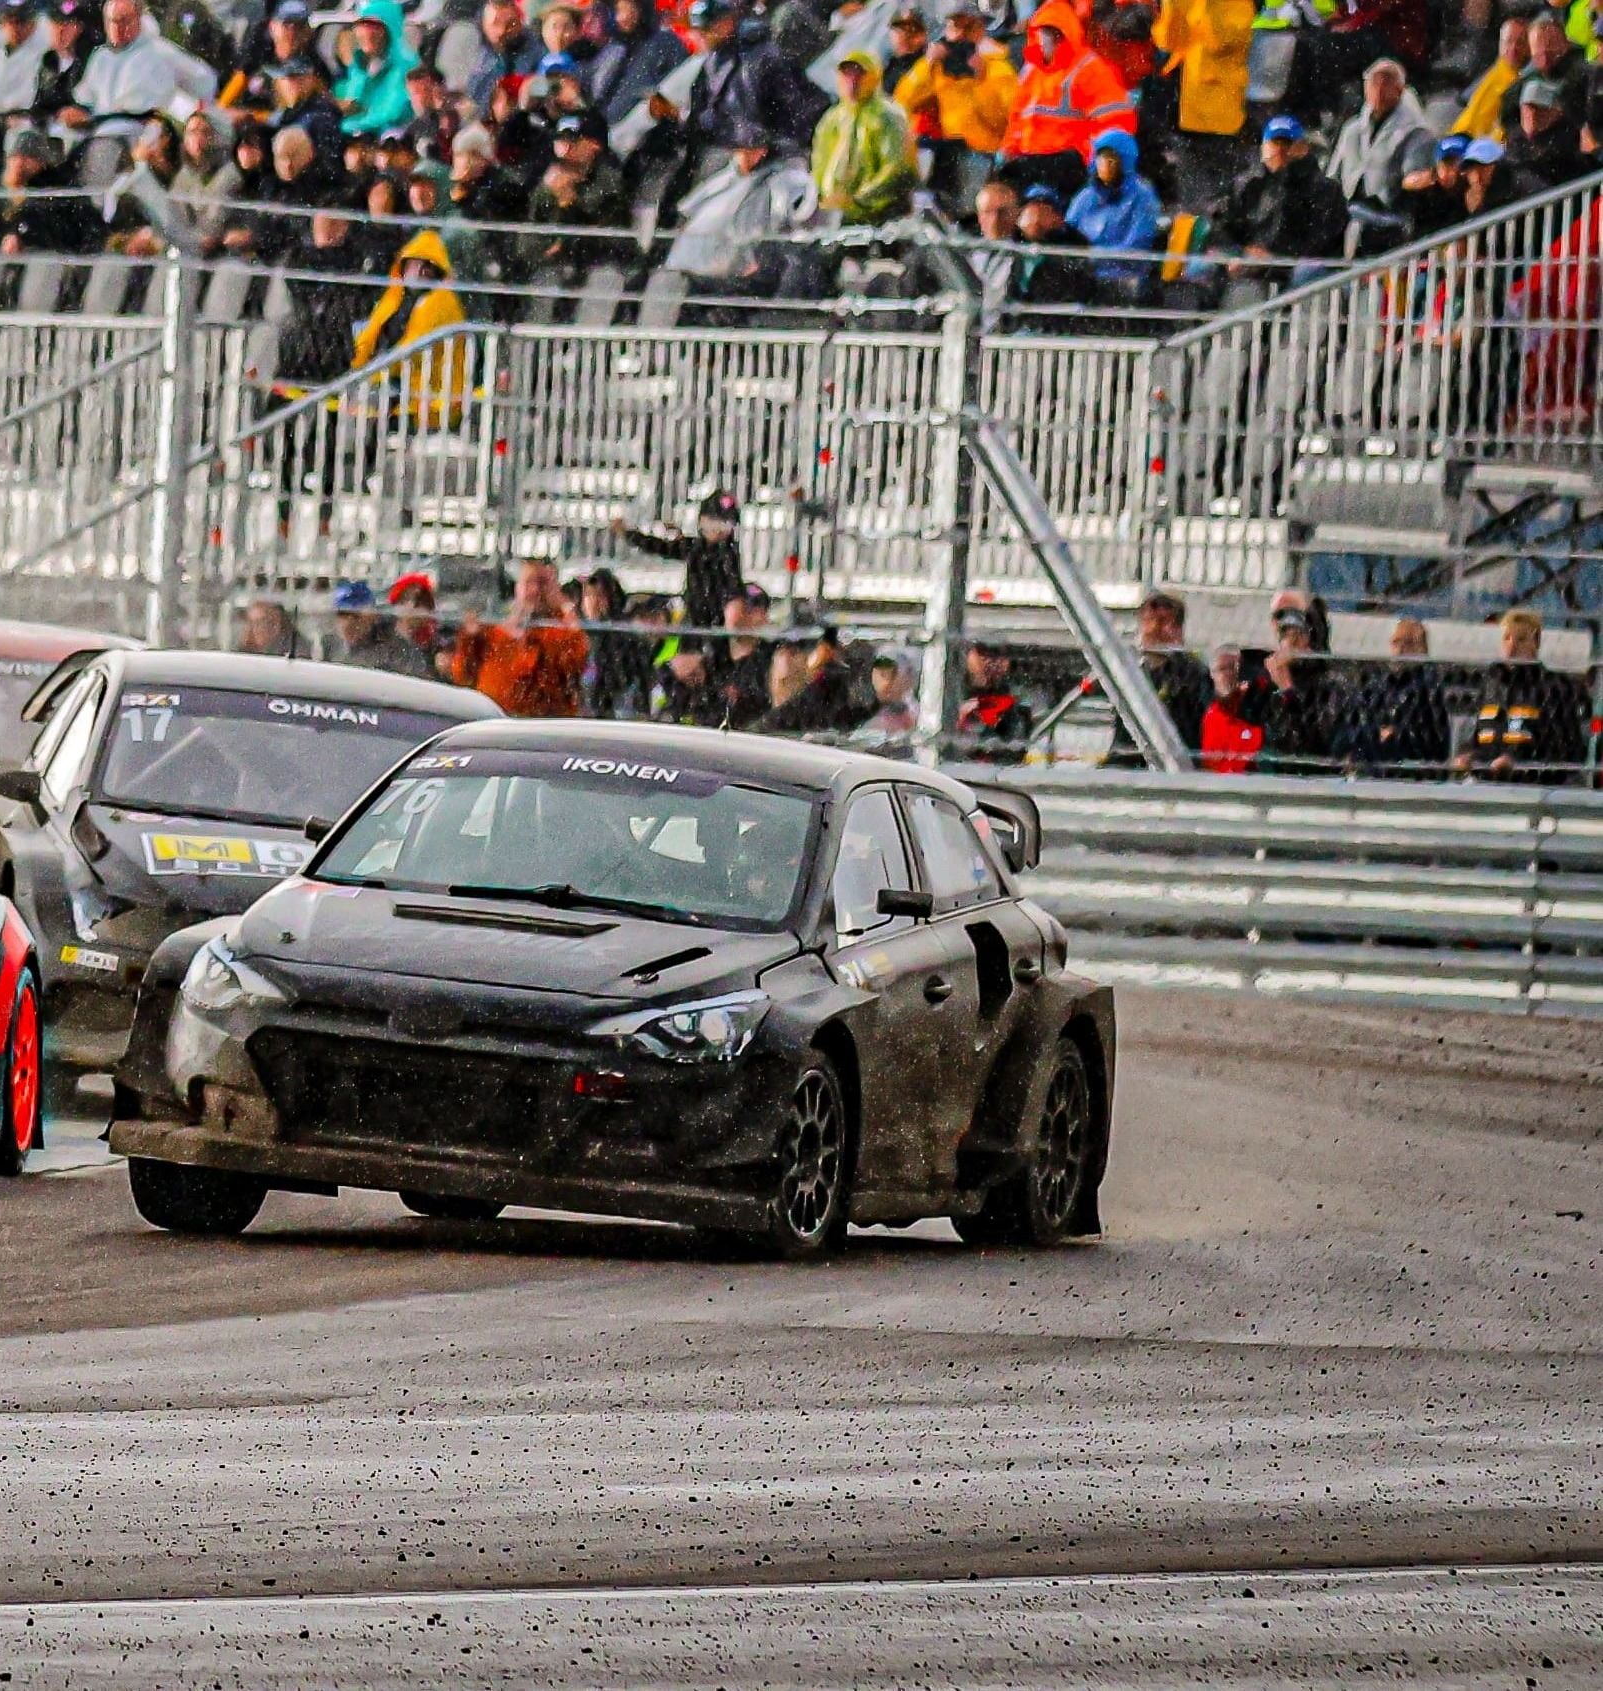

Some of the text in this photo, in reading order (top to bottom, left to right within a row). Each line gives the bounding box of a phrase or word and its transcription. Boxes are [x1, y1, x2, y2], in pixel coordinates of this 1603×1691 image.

[121, 708, 175, 742] 17
[406, 755, 474, 771] RX1
[561, 757, 680, 784] IKONEN
[370, 778, 446, 816] 76
